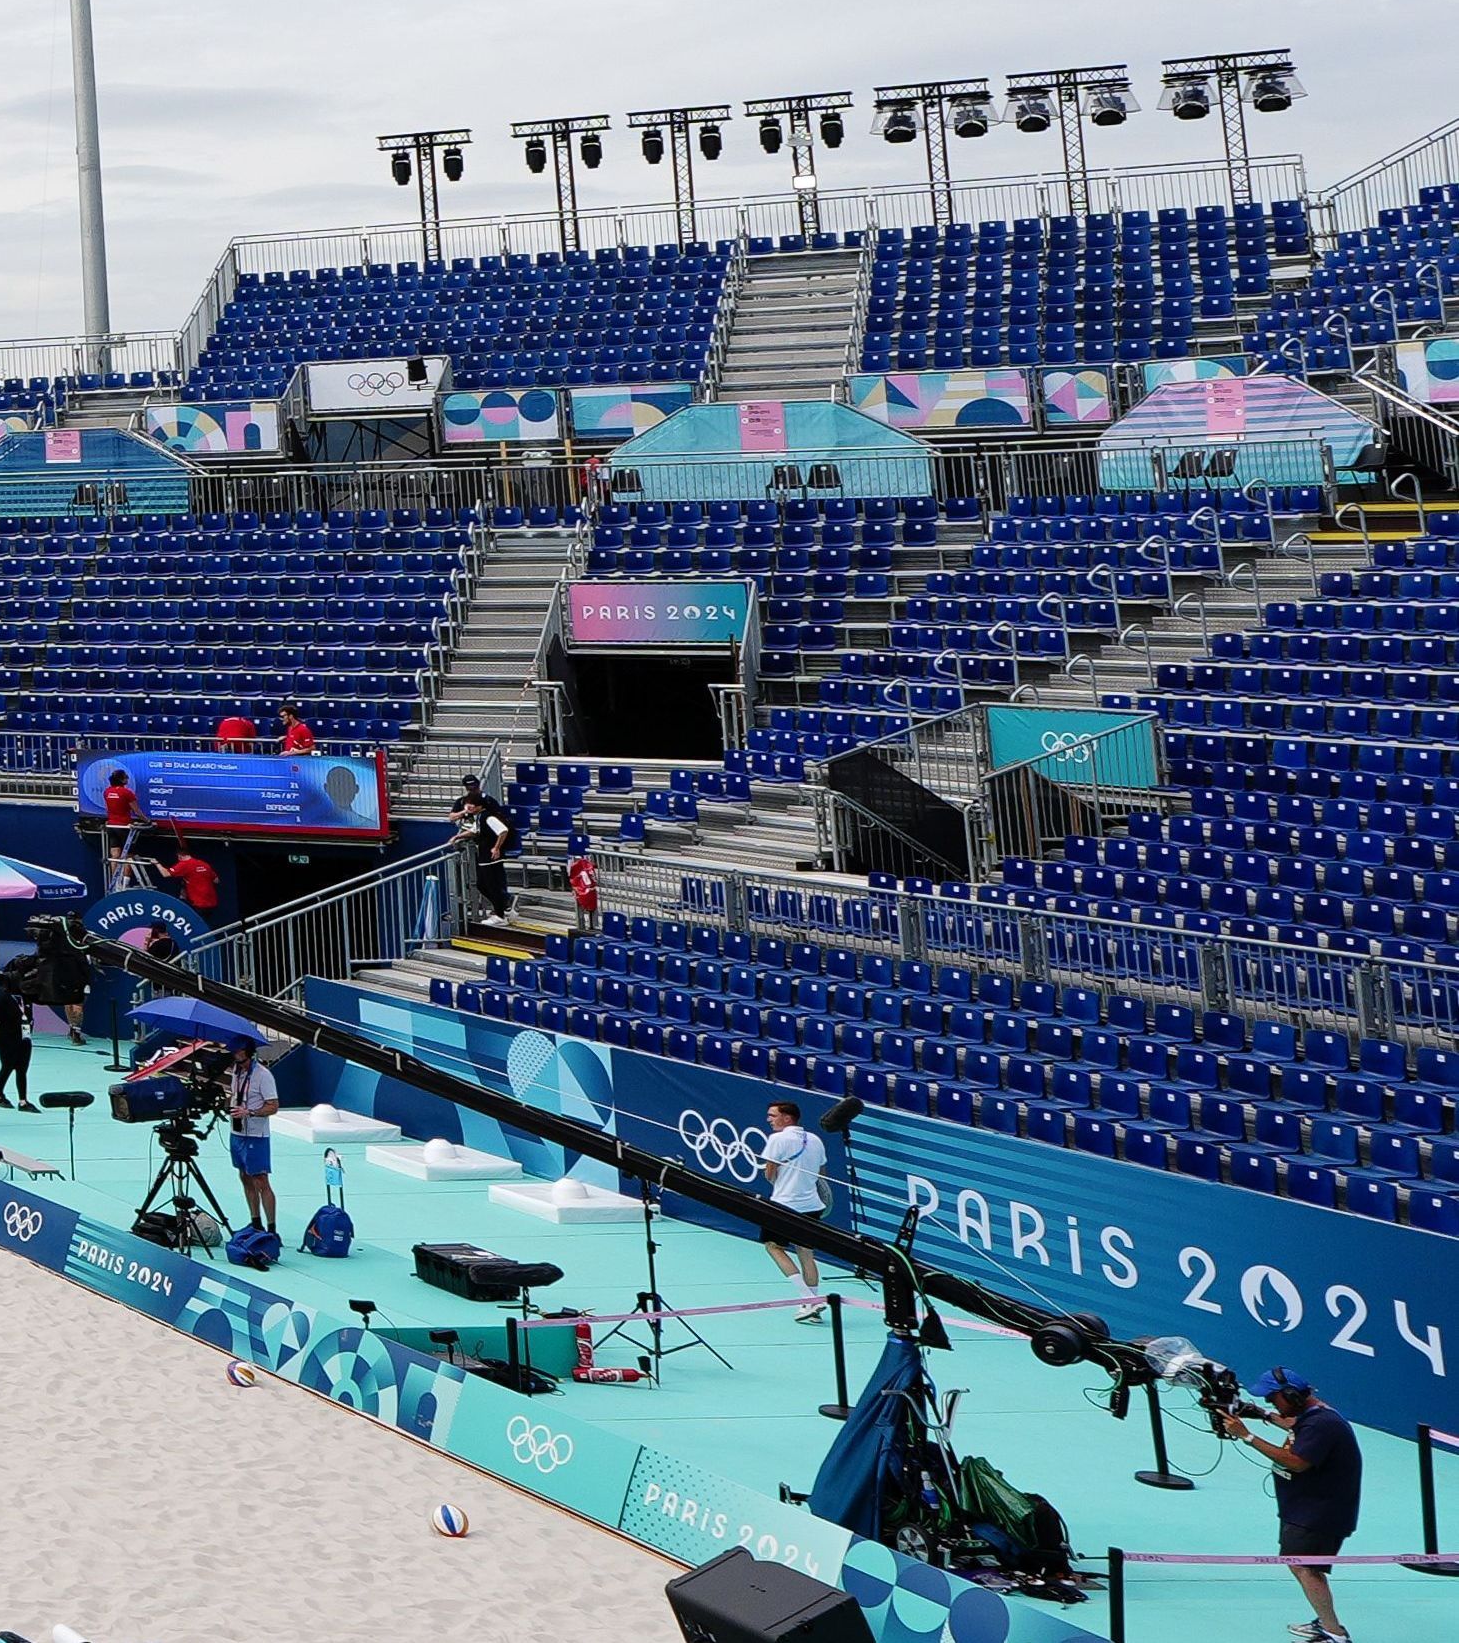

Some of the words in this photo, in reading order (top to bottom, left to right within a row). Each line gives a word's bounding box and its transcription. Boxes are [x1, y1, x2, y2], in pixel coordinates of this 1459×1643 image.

[666, 605, 736, 620] 2024
[150, 904, 194, 936] 2024
[126, 1261, 173, 1297] 2024
[1177, 1245, 1447, 1377] 2024
[738, 1524, 820, 1578] 2024
